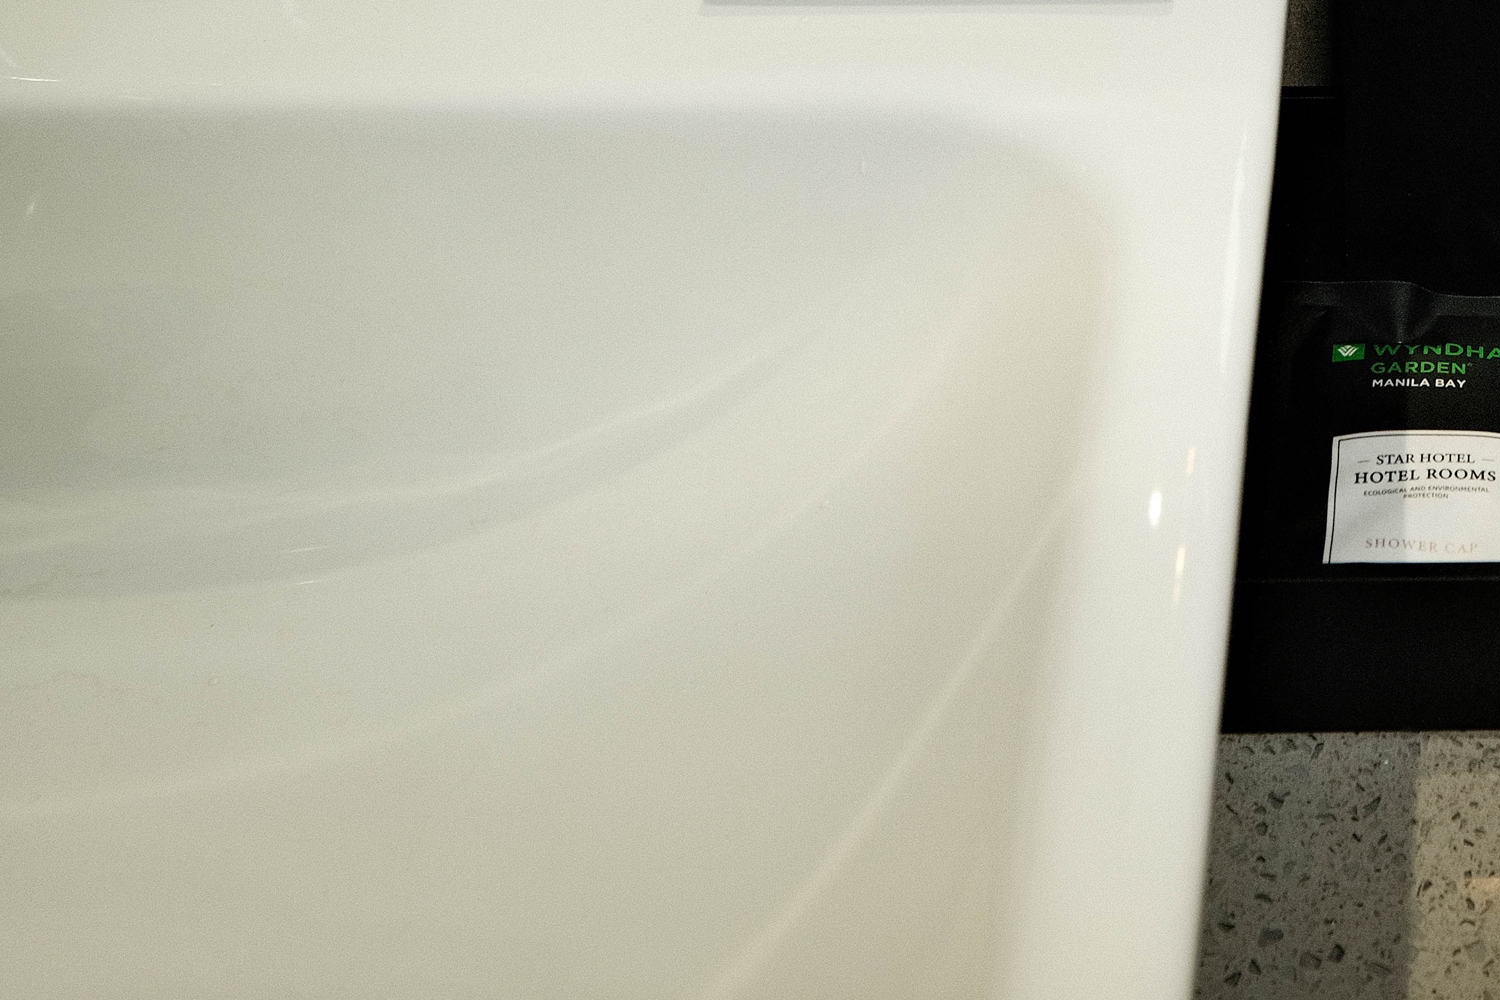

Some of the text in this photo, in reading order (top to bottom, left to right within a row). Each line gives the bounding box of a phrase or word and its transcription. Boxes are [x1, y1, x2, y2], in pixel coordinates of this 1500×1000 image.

[1372, 378, 1466, 388] MANILA BAY
[1376, 453, 1475, 465] STAR HOTEL
[1354, 468, 1496, 484] HOTEL ROOMS
[1365, 538, 1478, 554] SHOWER CAP
